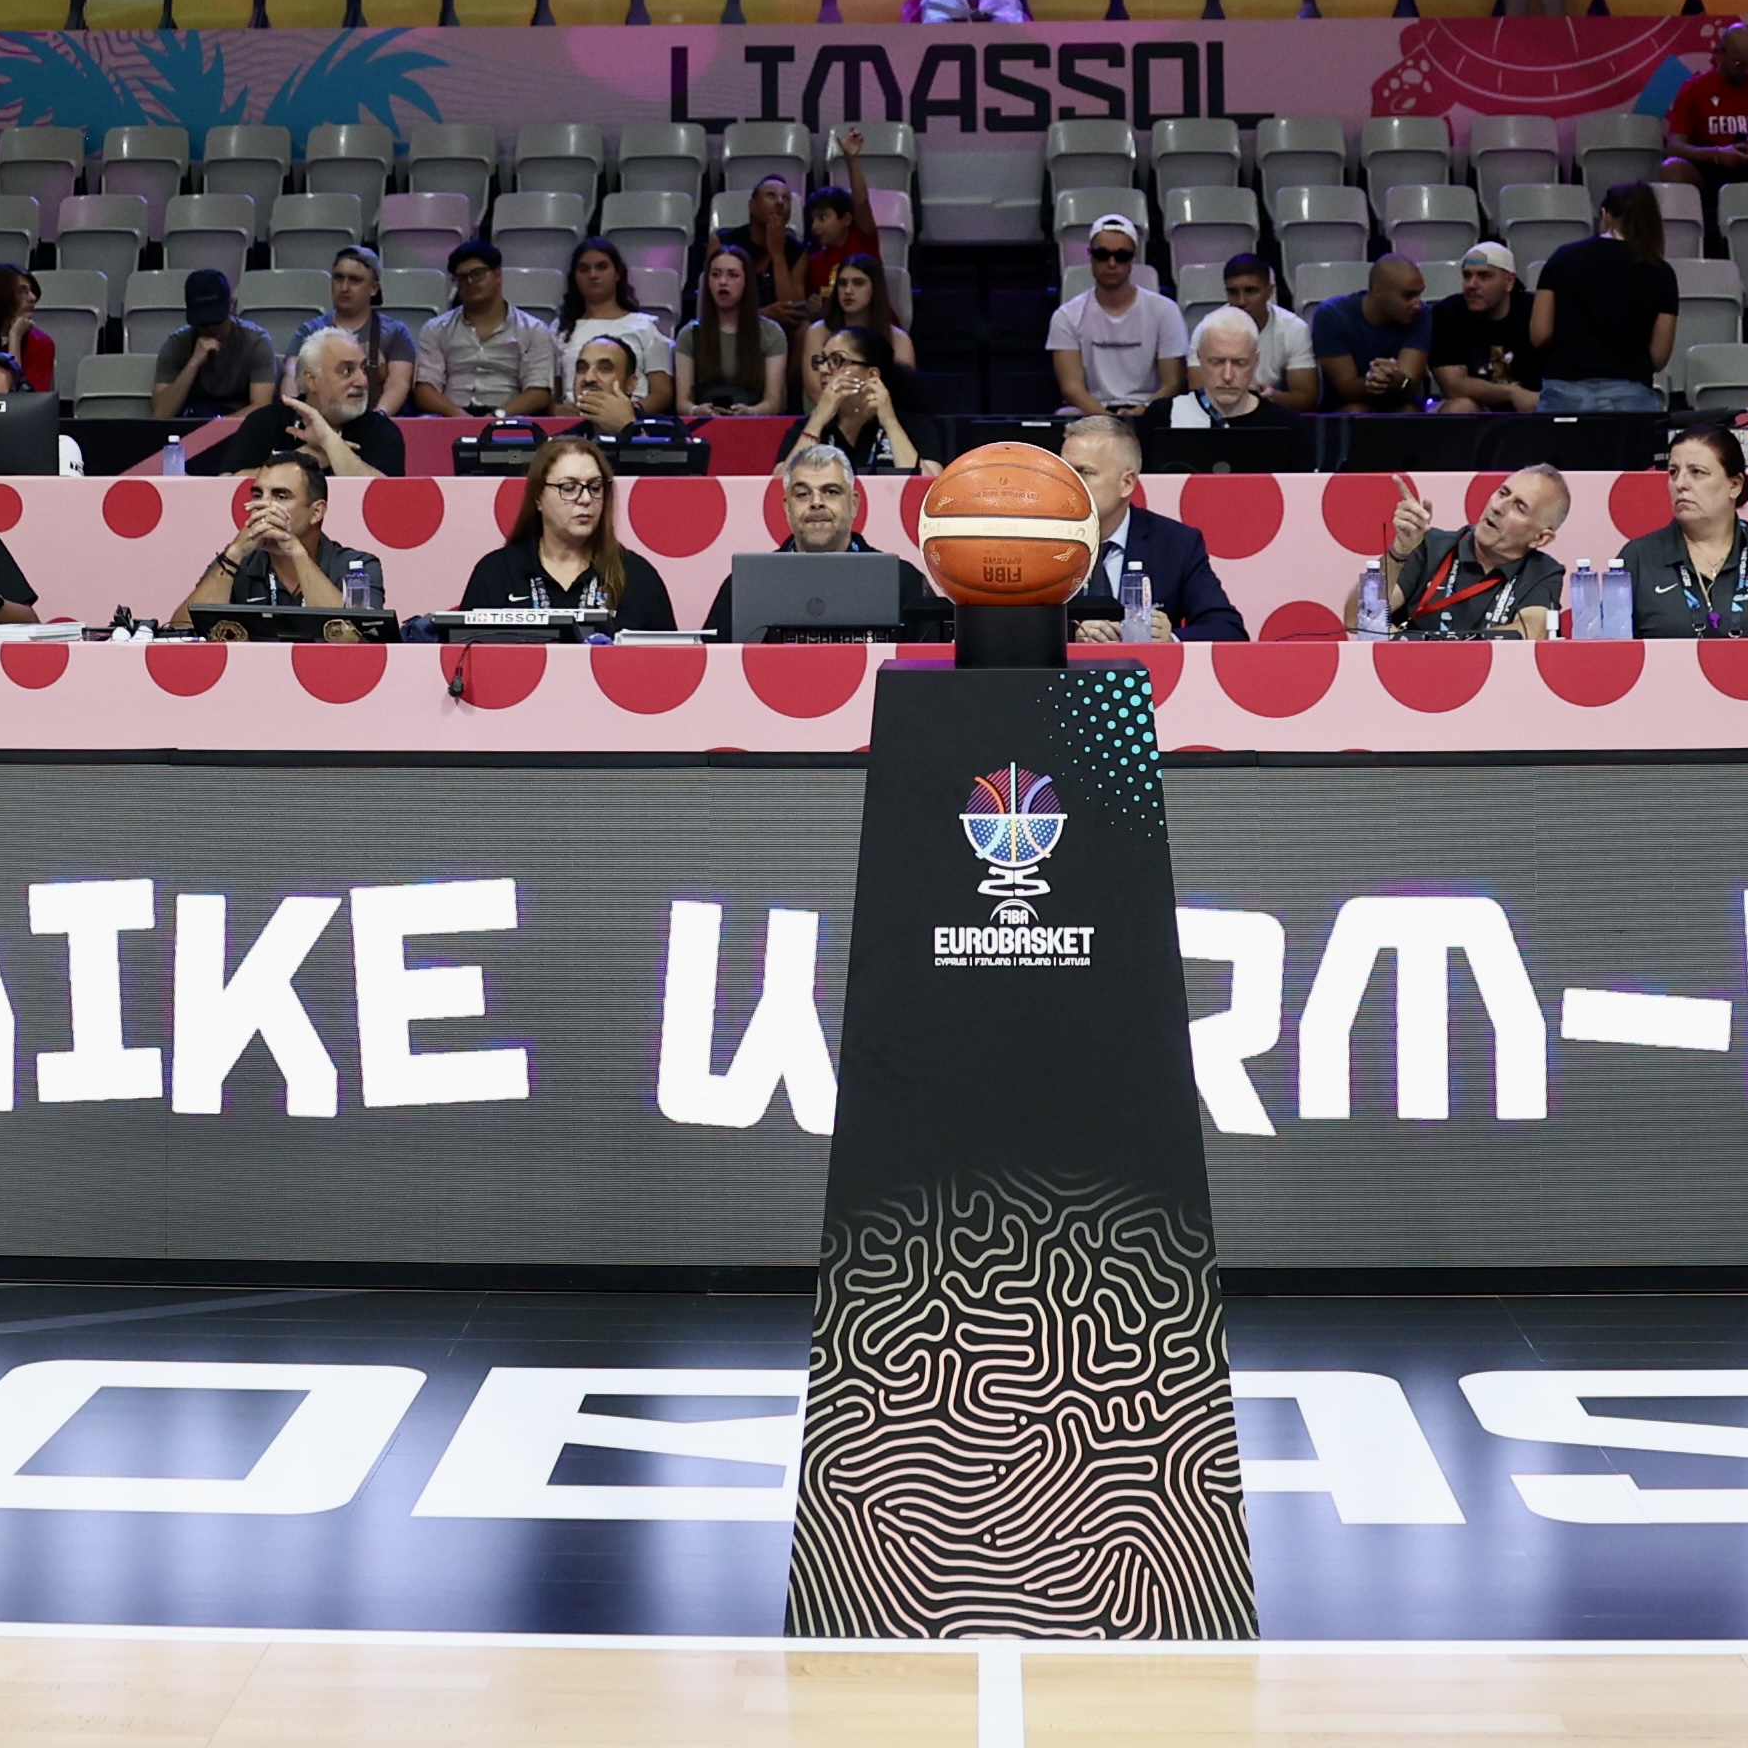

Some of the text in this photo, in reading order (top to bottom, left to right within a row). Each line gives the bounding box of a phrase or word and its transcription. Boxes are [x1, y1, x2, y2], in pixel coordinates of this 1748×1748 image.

[671, 42, 1274, 134] LIMASSOL
[982, 565, 1023, 583] FIBA
[490, 612, 548, 623] TISSOT
[999, 909, 1029, 925] FIBA
[934, 926, 1095, 955] EUROBASKET
[934, 957, 1091, 966] CYPRUS FINLAND POLAND LATVIA
